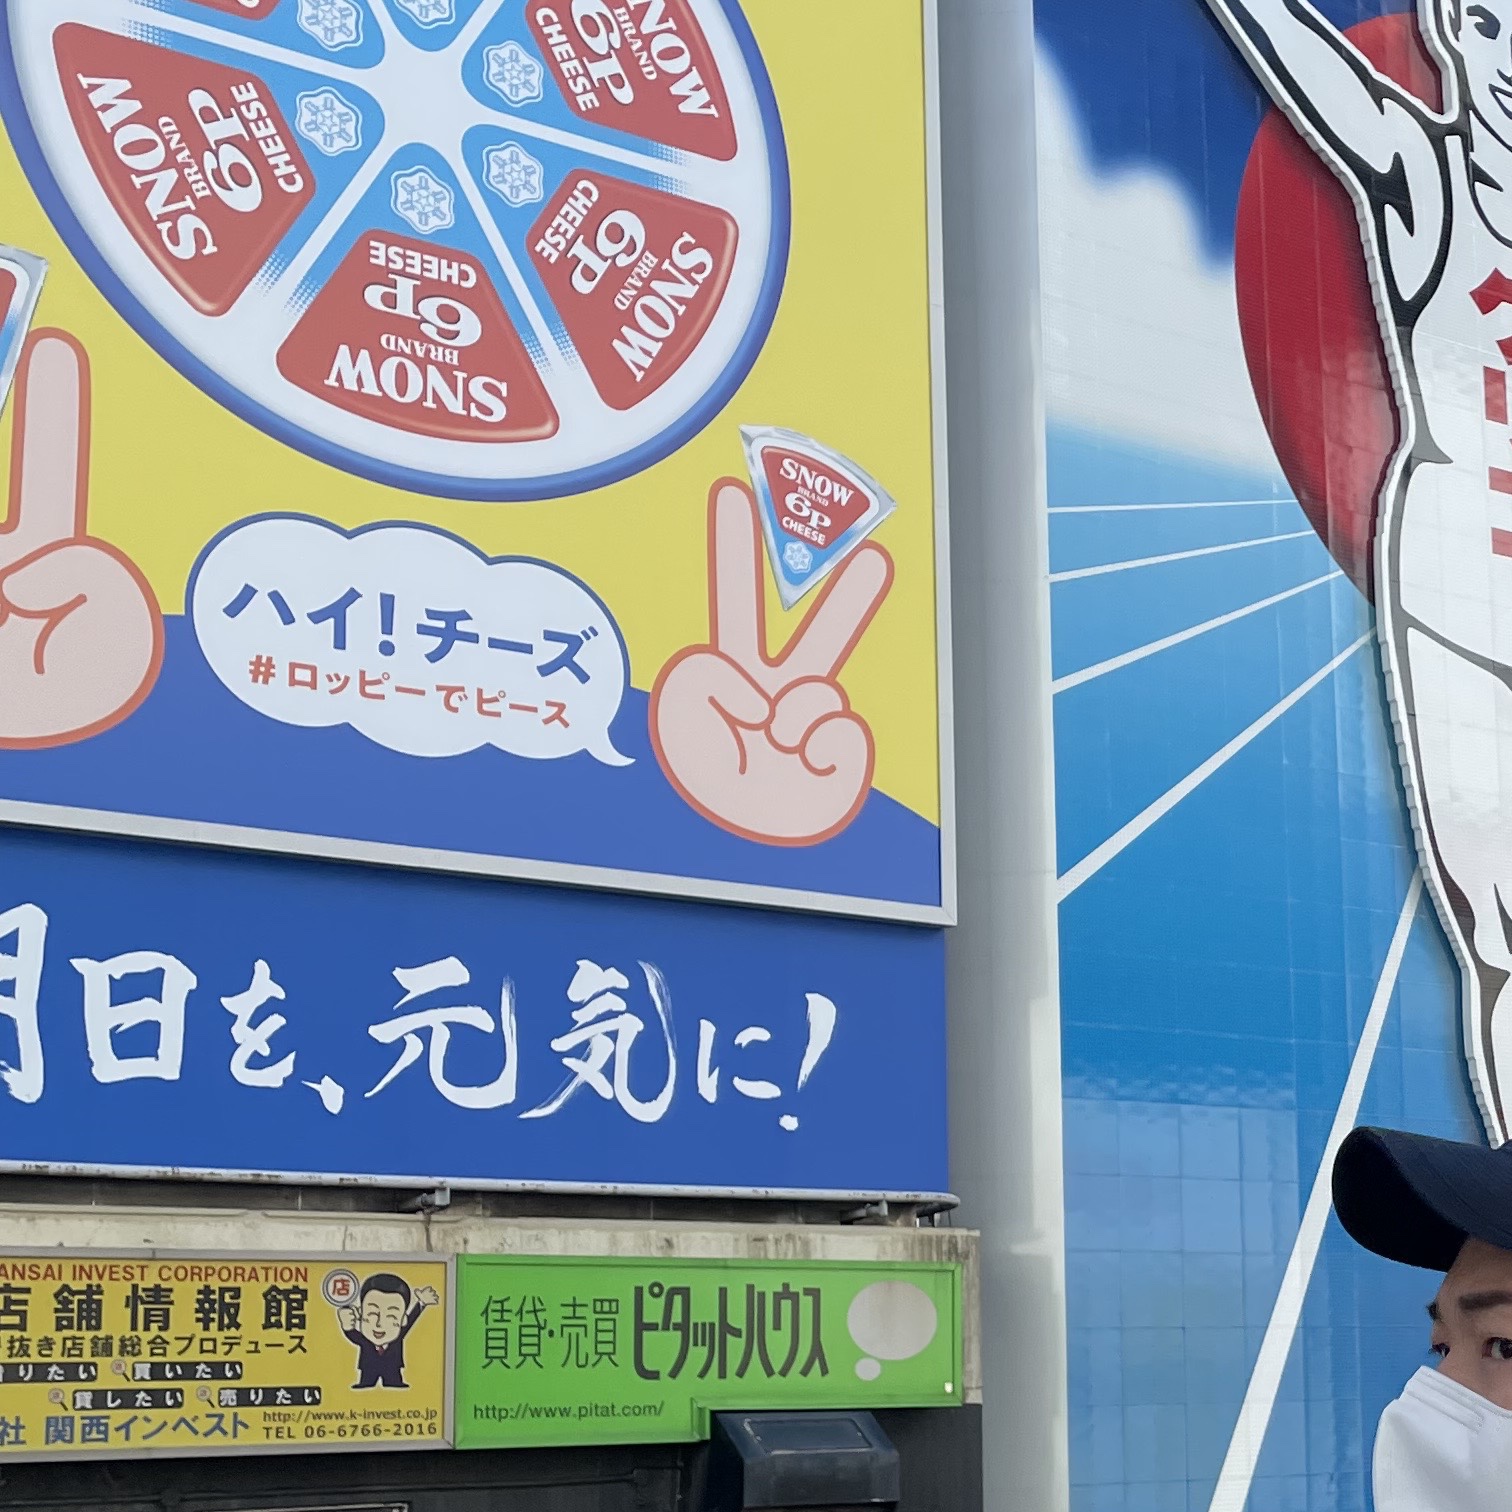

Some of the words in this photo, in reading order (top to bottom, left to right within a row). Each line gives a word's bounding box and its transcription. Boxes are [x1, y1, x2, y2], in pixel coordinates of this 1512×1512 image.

[535, 7, 600, 112] CHEESE
[571, 0, 634, 106] 6P
[613, 7, 657, 81] BRAND
[627, 0, 719, 118] NOW
[158, 115, 212, 200] BRAND
[187, 89, 264, 213] 6P
[229, 81, 304, 193] CHEESE
[77, 72, 217, 261] SNOW
[535, 180, 599, 264] CHEESE
[369, 240, 477, 289] CHEESE
[570, 209, 646, 295] 6P
[613, 251, 658, 311] BRAND
[362, 273, 482, 348] 6P
[612, 231, 714, 382] SNOW
[380, 333, 459, 366] BRAND
[323, 343, 508, 423] SNOW
[779, 458, 854, 507] SNOW
[797, 486, 829, 507] BRAND
[782, 516, 826, 546] CHEESE
[785, 492, 831, 529] 6P
[72, 1264, 149, 1282] INVEST
[158, 1265, 309, 1283] CORPORATION
[332, 1278, 351, 1297] 店
[0, 1283, 309, 1332] 店舗情報館
[480, 1295, 620, 1370] 賃貸・売買
[634, 1281, 829, 1381] ピタットハウス
[0, 1333, 308, 1358] 抜き店舗総合プロデュース
[0, 1364, 97, 1383] りたい
[134, 1363, 242, 1380] 買いたい
[220, 1388, 320, 1407] 売りたい
[263, 1408, 438, 1424] http://www.k-invest.co.jp
[473, 1399, 665, 1422] http://www.pitat.com/
[45, 1412, 250, 1446] 関西インベスト
[263, 1426, 296, 1440] TEL
[304, 1423, 438, 1439] 06-6766-2016
